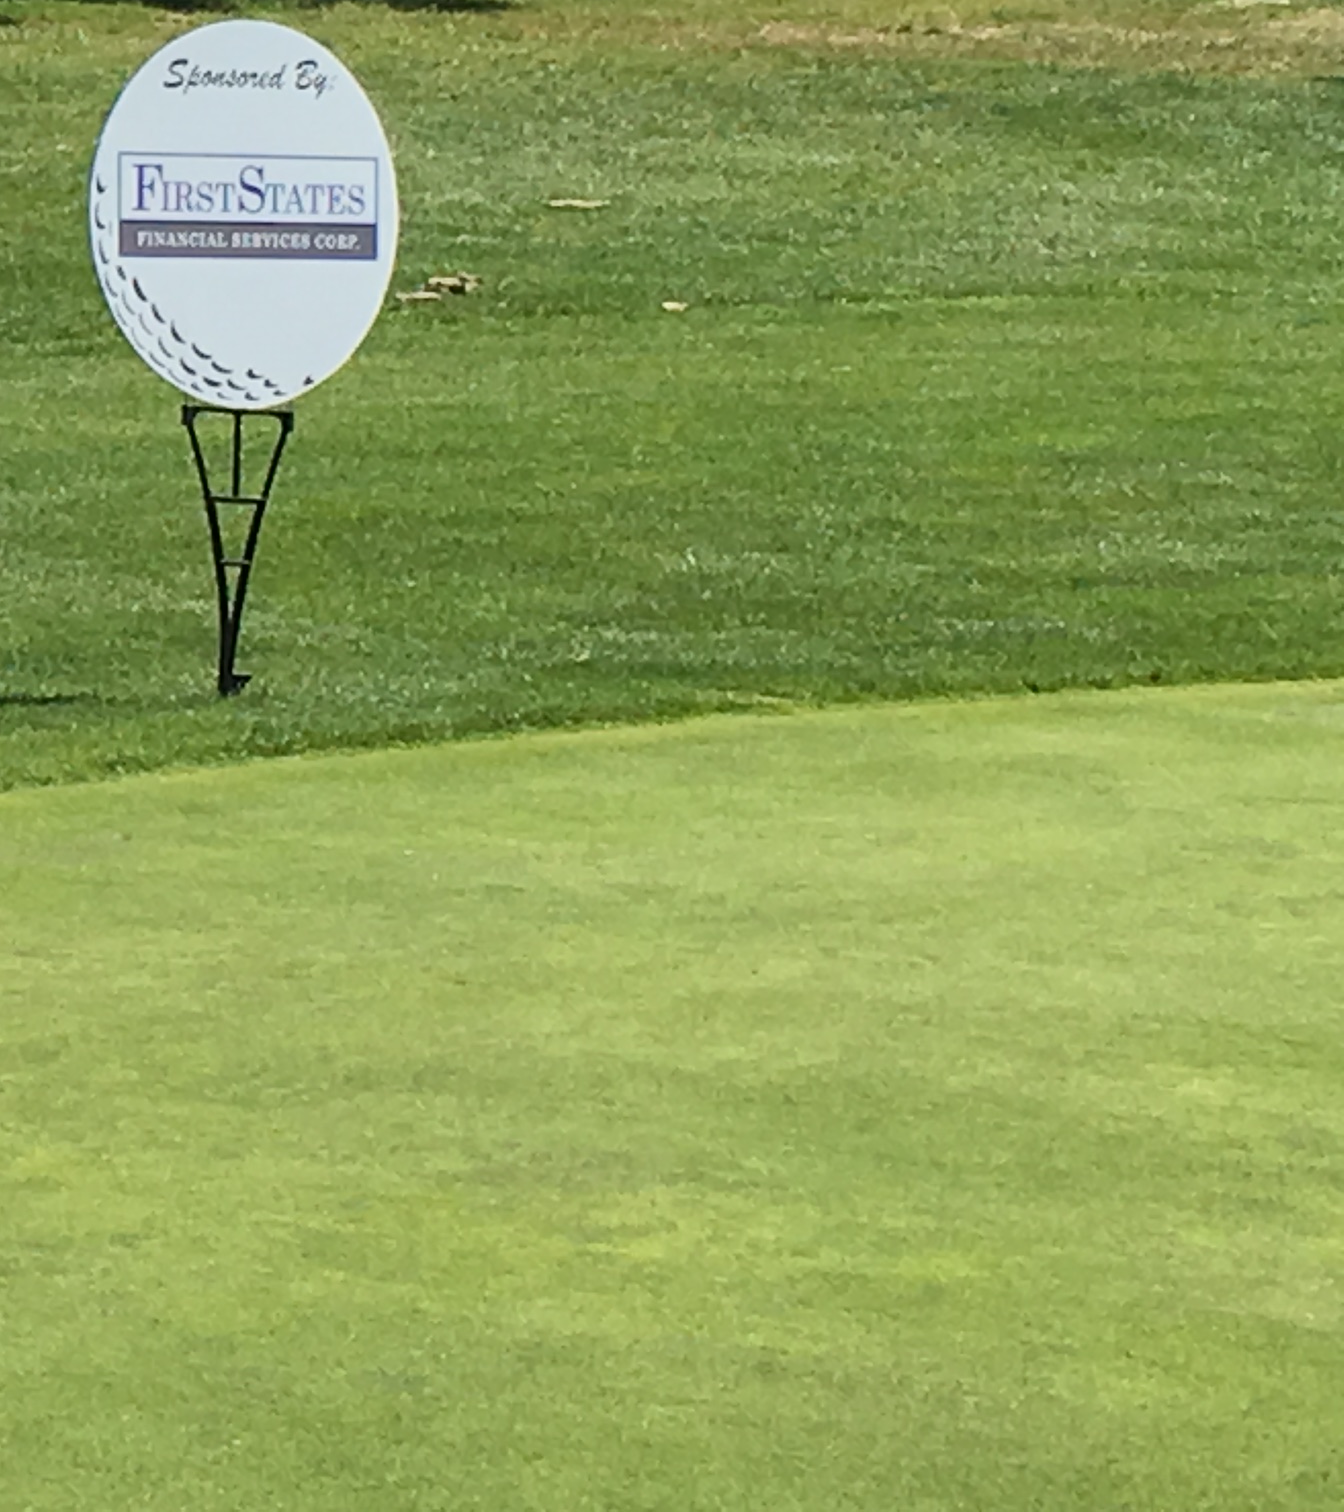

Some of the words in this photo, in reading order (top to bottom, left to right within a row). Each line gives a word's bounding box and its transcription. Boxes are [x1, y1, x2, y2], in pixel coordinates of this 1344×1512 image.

[163, 58, 286, 95] Sponsored
[295, 59, 337, 98] By:
[137, 230, 229, 250] FINANCIAL
[231, 230, 311, 250] SERVICES
[315, 232, 361, 251] CORP.
